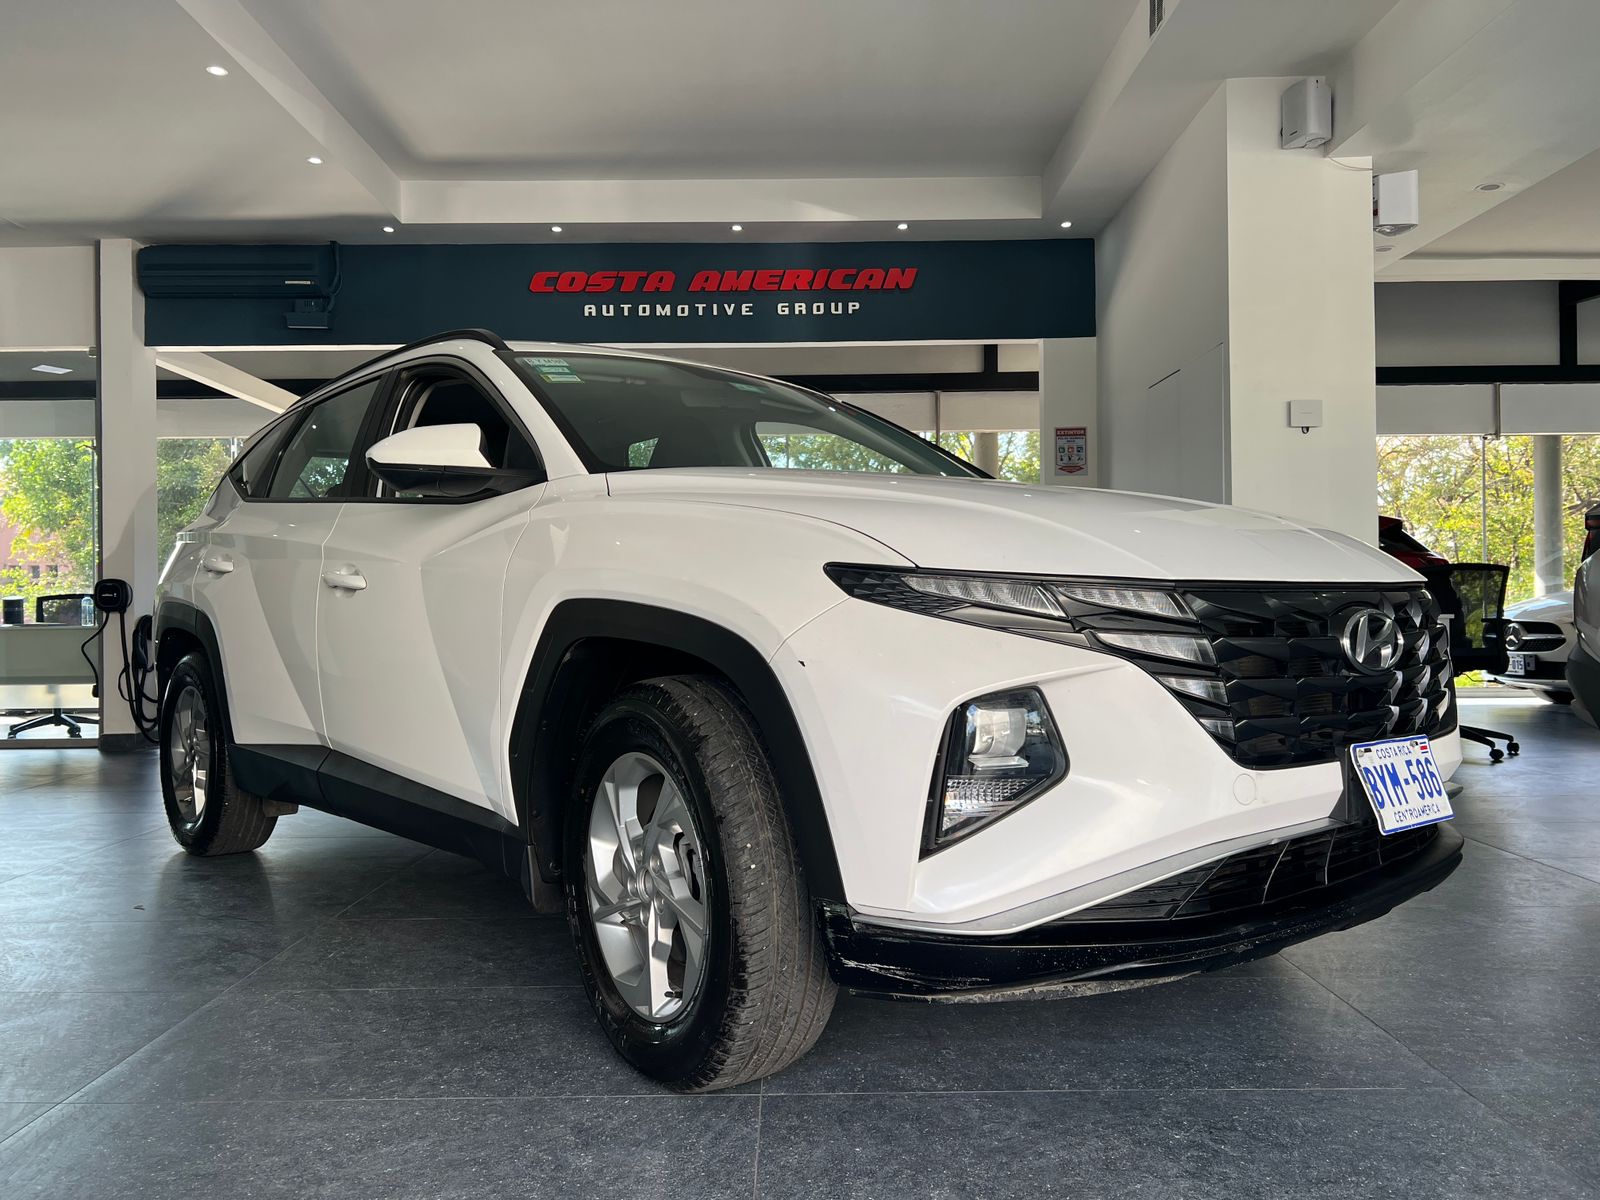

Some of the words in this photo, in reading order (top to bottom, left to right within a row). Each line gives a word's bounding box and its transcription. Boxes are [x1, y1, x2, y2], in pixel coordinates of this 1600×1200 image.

[529, 271, 676, 292] COSTA
[688, 268, 918, 292] AMERICAN
[583, 303, 753, 317] AUTOMOTIVE
[777, 302, 860, 315] GROUP
[1376, 746, 1399, 759] COSTA
[1397, 744, 1412, 756] RICA
[1362, 757, 1442, 809] BYM-586
[1394, 803, 1440, 823] CENTROAMERICA
